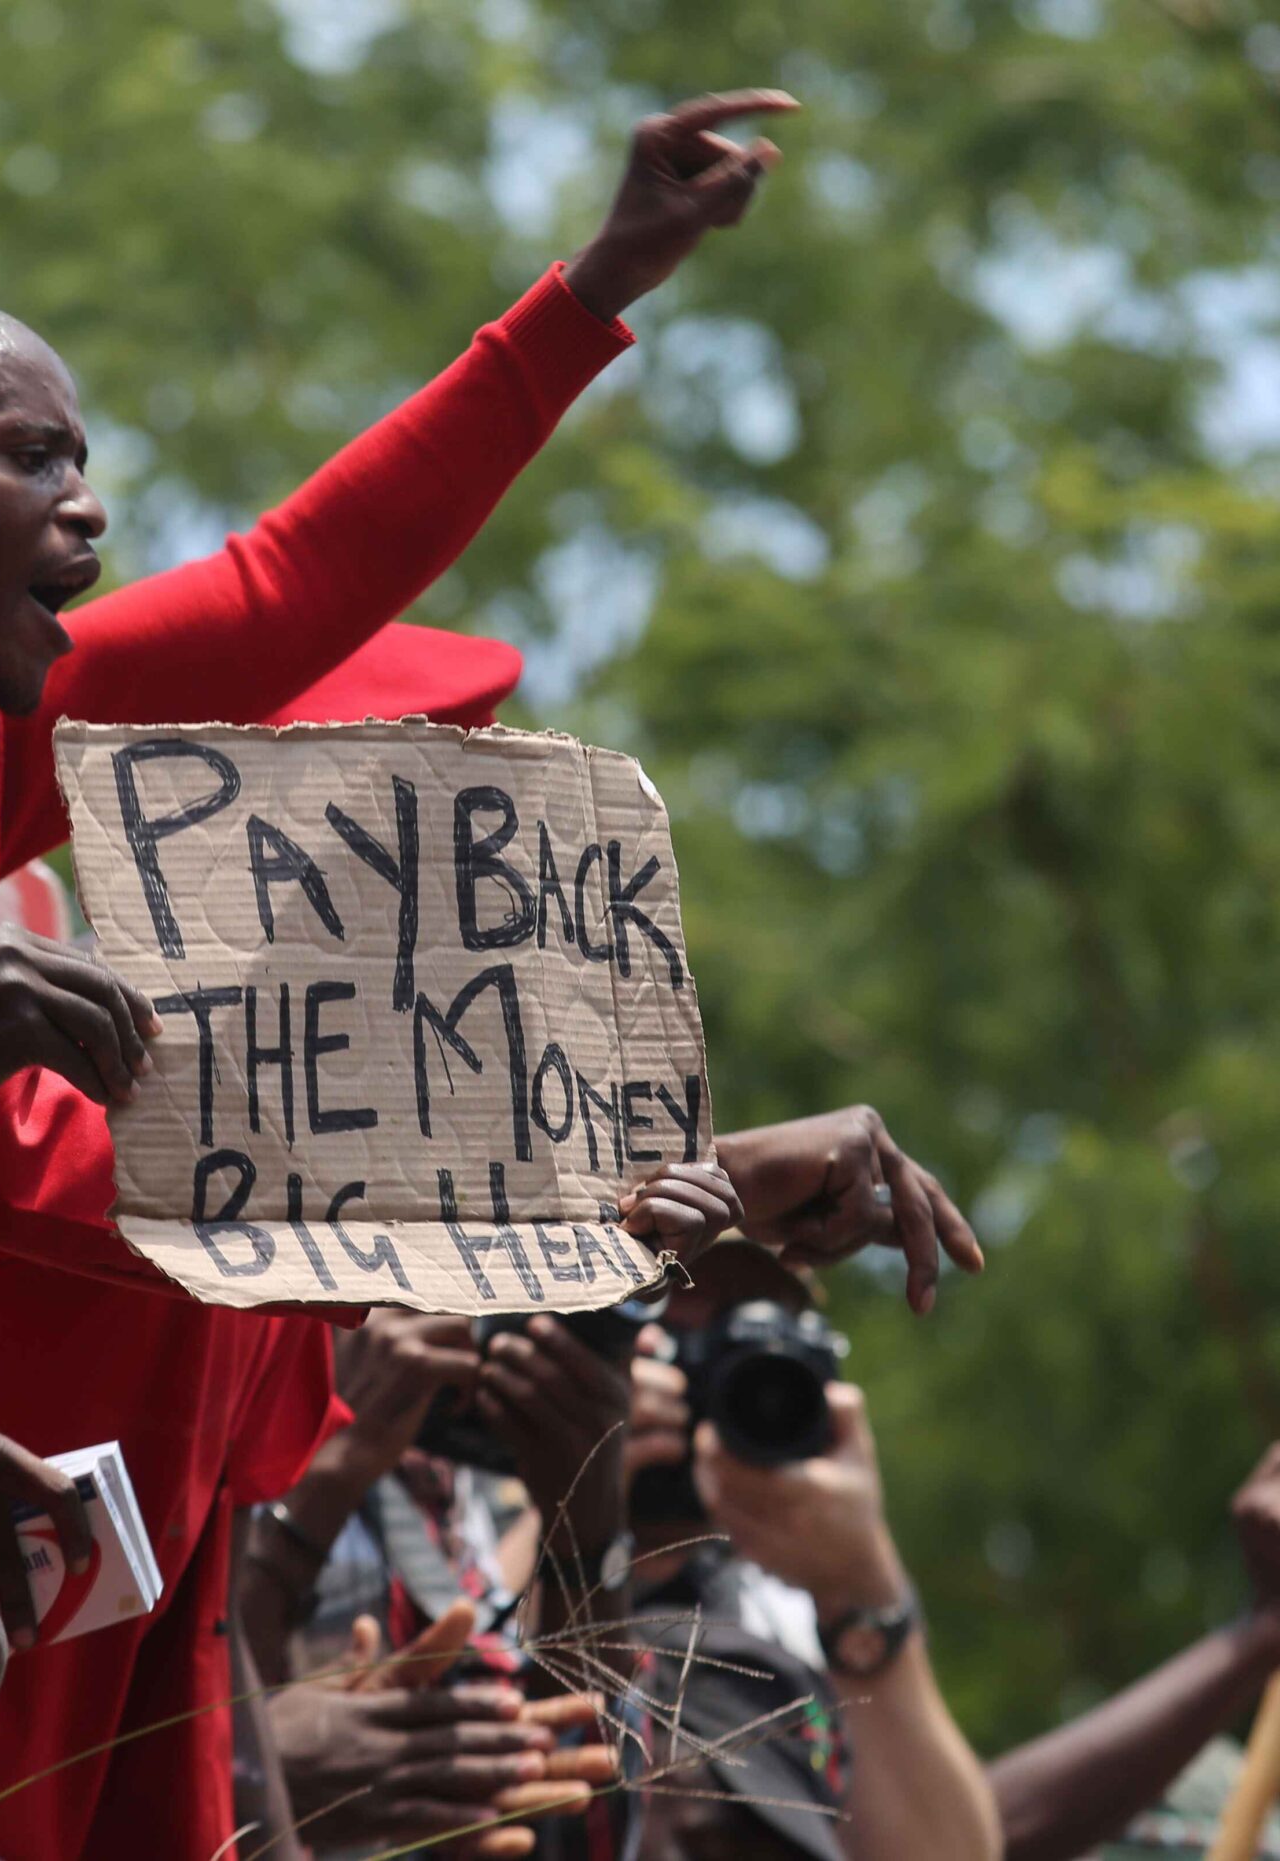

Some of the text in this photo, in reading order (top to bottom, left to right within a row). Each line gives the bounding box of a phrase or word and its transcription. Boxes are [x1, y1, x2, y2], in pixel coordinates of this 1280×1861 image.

[111, 738, 683, 1013] PAY BACK
[152, 963, 700, 1177] THE MONEY
[192, 1148, 413, 1292] BIG
